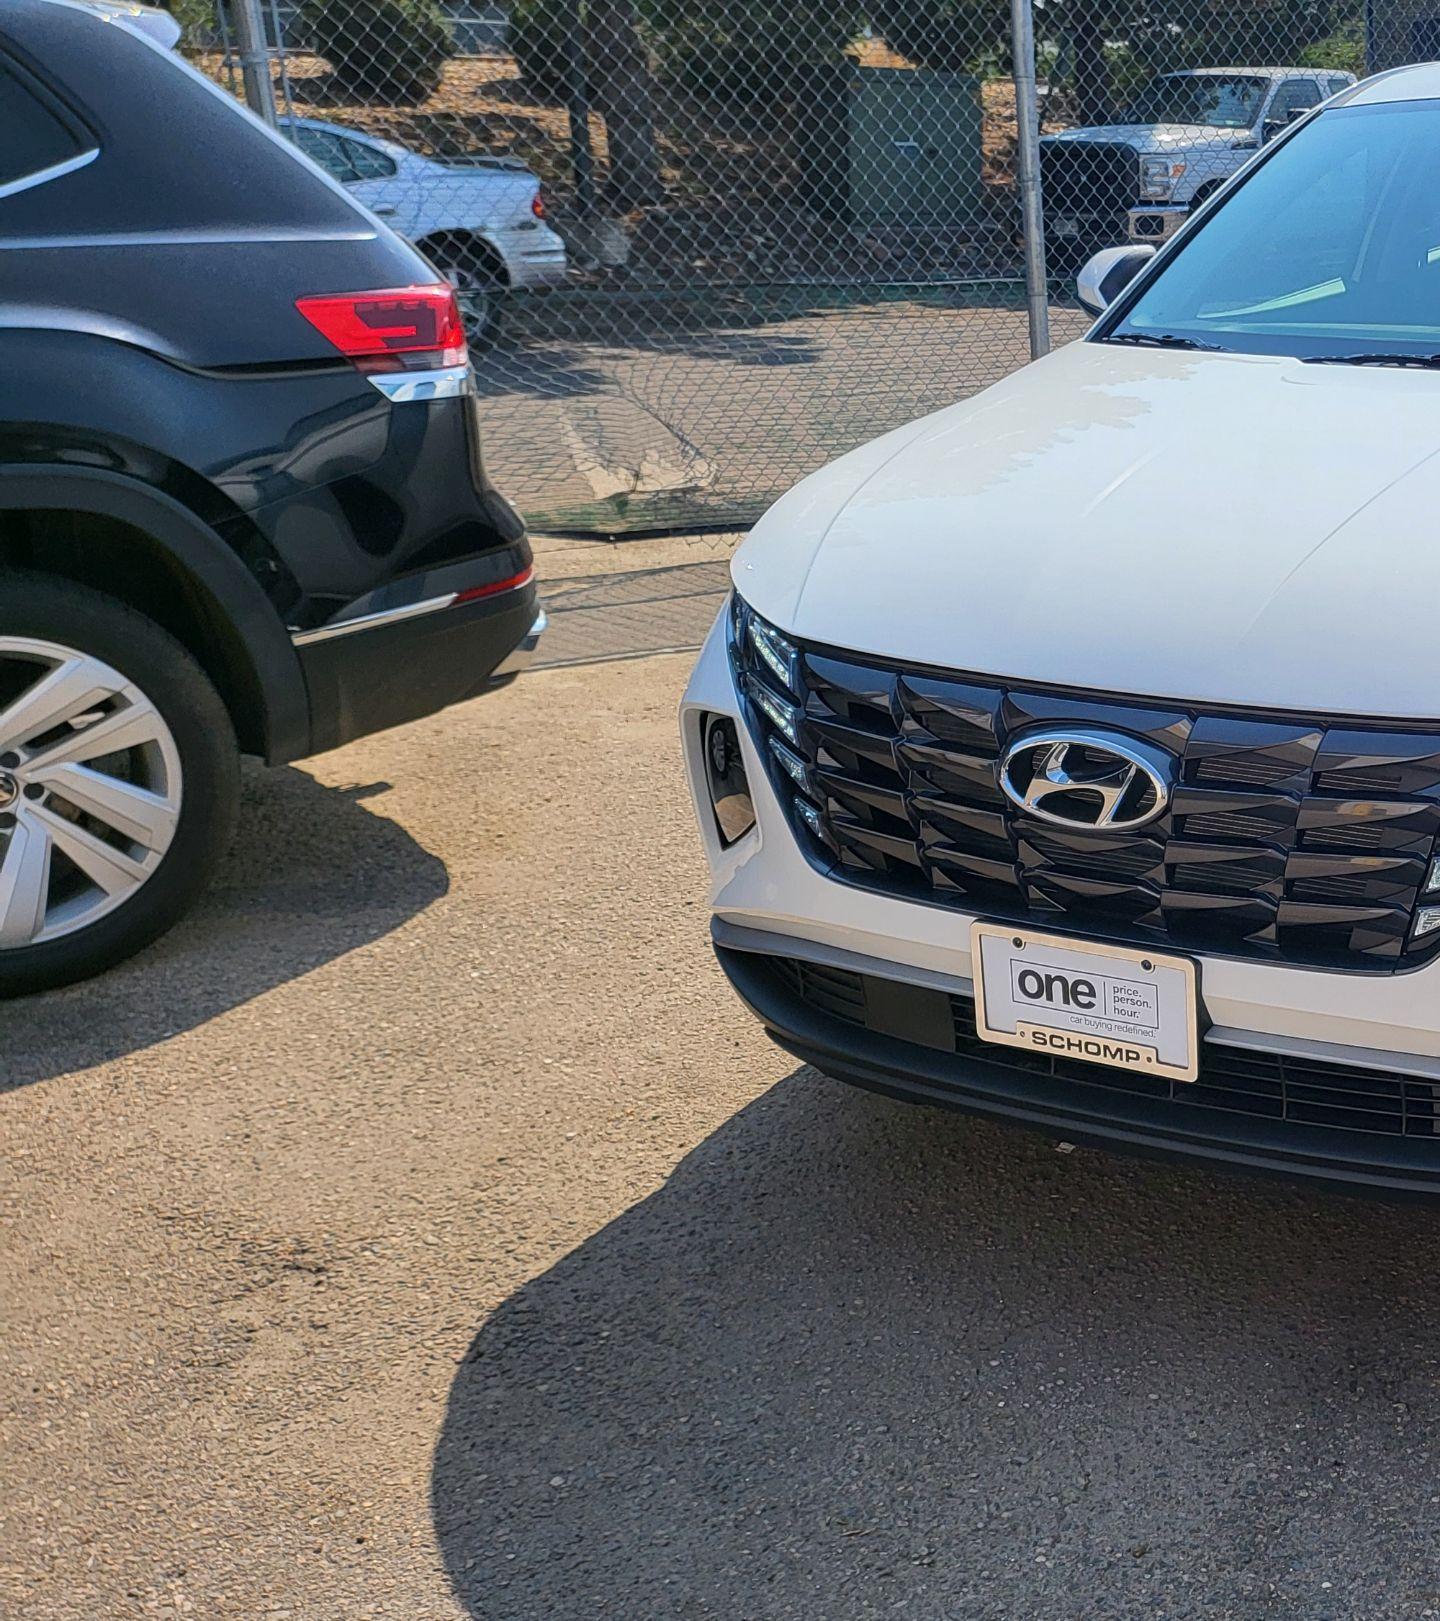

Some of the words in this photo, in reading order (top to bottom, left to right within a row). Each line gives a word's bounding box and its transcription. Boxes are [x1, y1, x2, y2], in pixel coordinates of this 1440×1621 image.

[1017, 969, 1097, 1010] one
[1112, 985, 1142, 998] price.
[1113, 995, 1152, 1009] person.
[1069, 1015, 1083, 1024] car
[1084, 1016, 1113, 1031] buying
[1031, 1031, 1141, 1063] SCHOMP
